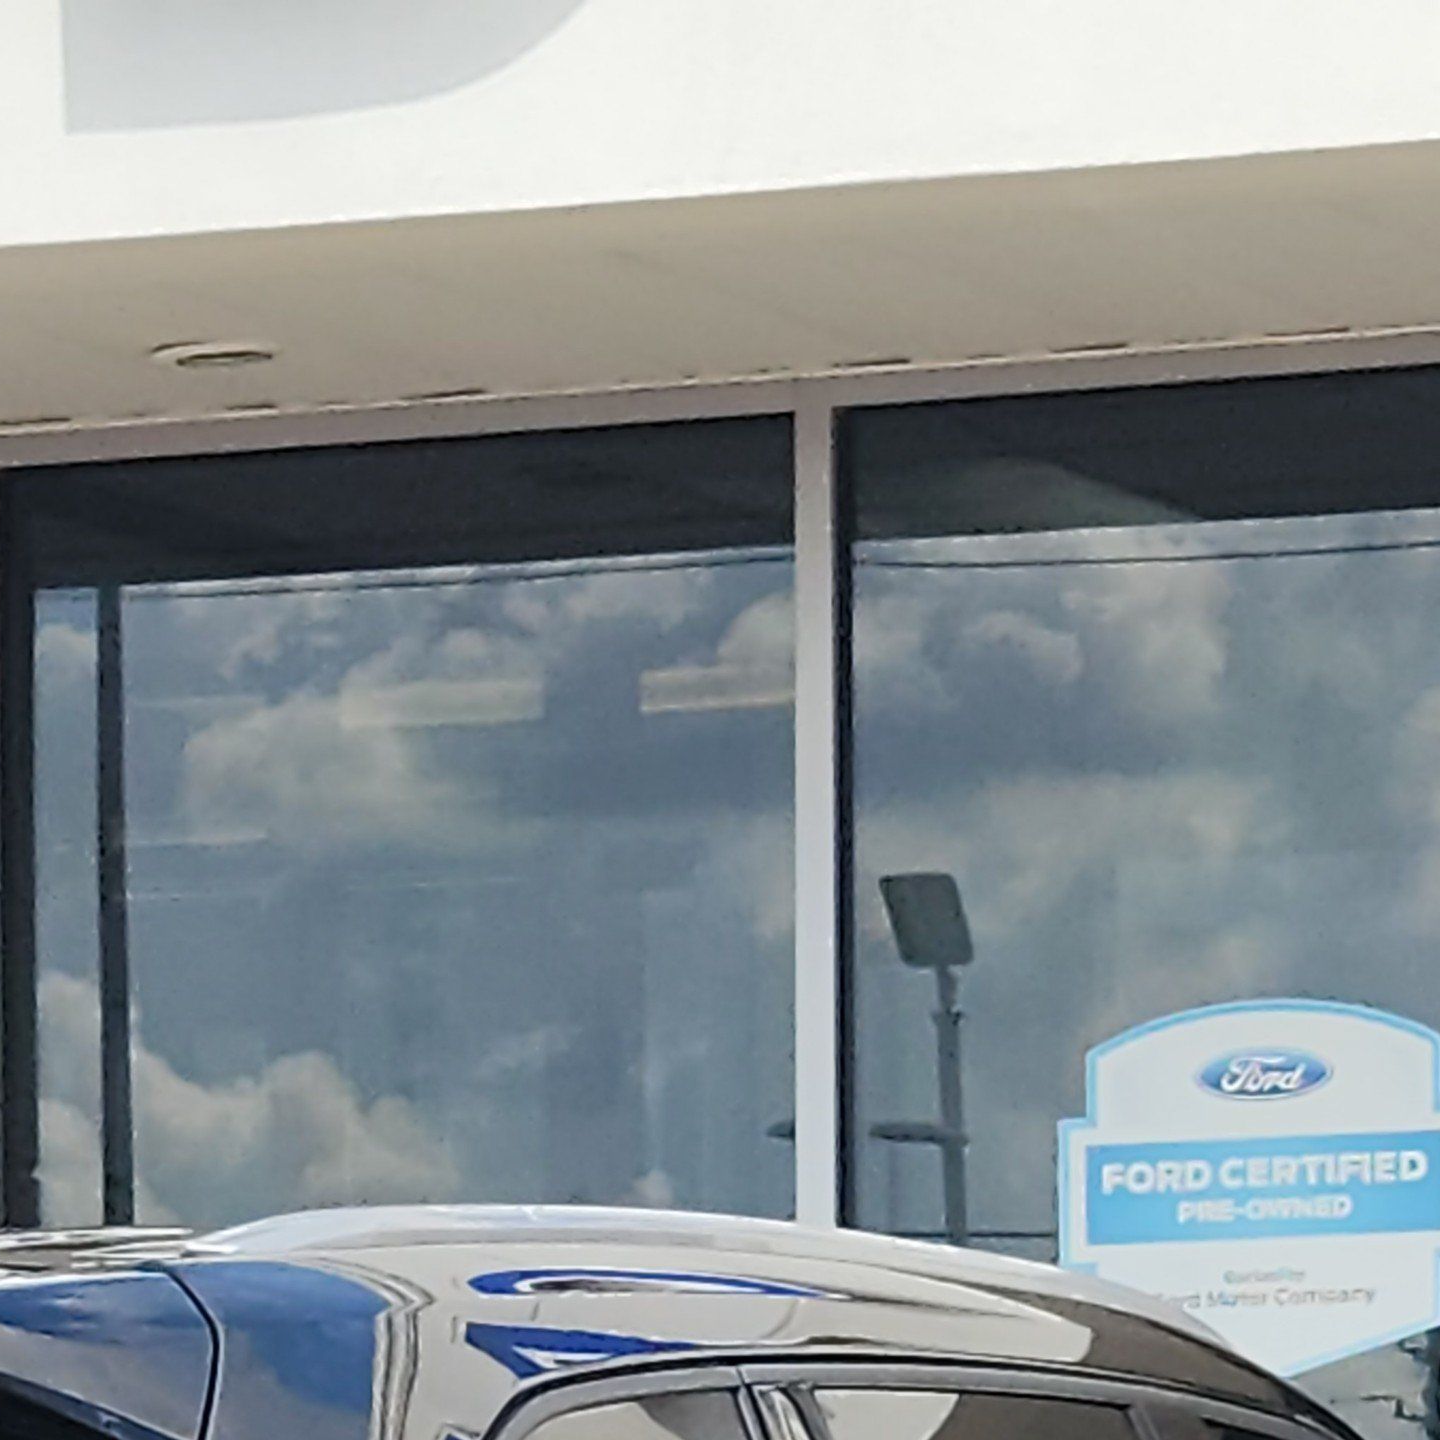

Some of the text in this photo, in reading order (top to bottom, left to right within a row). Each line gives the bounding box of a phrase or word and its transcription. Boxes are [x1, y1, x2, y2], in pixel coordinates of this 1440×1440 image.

[1221, 1056, 1306, 1092] Ford
[1101, 1149, 1429, 1195] FORD CERTIFIED
[1177, 1193, 1354, 1224] PRE-OWNED
